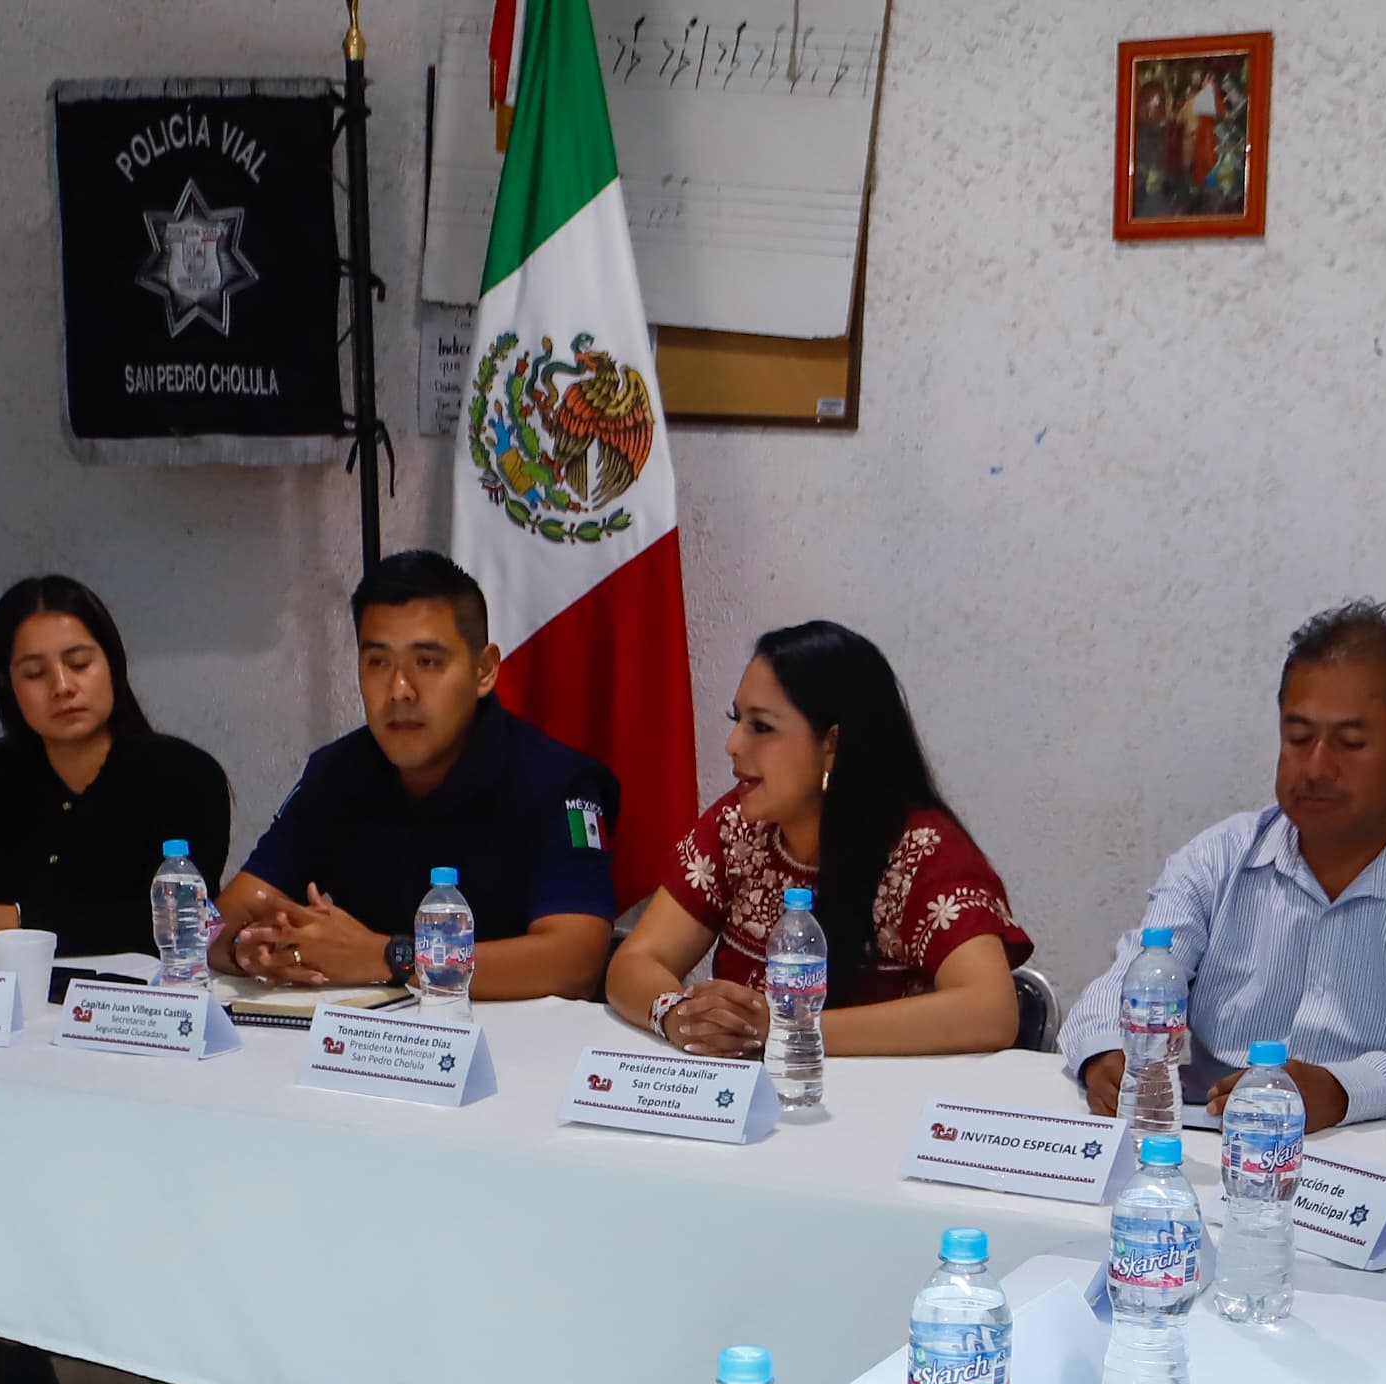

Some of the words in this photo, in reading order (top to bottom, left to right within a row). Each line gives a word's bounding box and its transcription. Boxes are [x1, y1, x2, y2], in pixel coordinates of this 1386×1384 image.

[116, 104, 211, 183] POLICÍA
[221, 121, 267, 184] VIAL
[125, 363, 154, 394] SAN
[157, 363, 206, 394] PEDRO
[210, 363, 279, 396] CHOLULA
[80, 999, 111, 1011] Capitán
[112, 1002, 130, 1013] Juan
[132, 1004, 161, 1017] Villegas
[163, 1007, 193, 1019] Castillo
[95, 1023, 130, 1036] Seguridad
[130, 1027, 169, 1040] Ciudadana
[148, 1018, 158, 1028] de
[337, 1024, 381, 1041] Tonantzin
[382, 1030, 430, 1047] Fernández
[349, 1039, 393, 1054] Presidenta
[394, 1046, 436, 1060] Municipal
[351, 1051, 366, 1062] San
[368, 1053, 392, 1066] Pedro
[393, 1057, 425, 1070] Cholula
[618, 1061, 676, 1077] Presidencia
[677, 1066, 718, 1081] Auxiliar
[631, 1078, 650, 1091] San
[652, 1080, 699, 1095] Cristóbal
[636, 1095, 681, 1111] Tepontla
[960, 1129, 1021, 1148] INVITADO
[1022, 1138, 1078, 1156] ESPECIAL
[1300, 1177, 1329, 1193] cción
[1330, 1184, 1345, 1198] de
[1294, 1195, 1349, 1221] Municipal
[1118, 1244, 1182, 1281] Skarch
